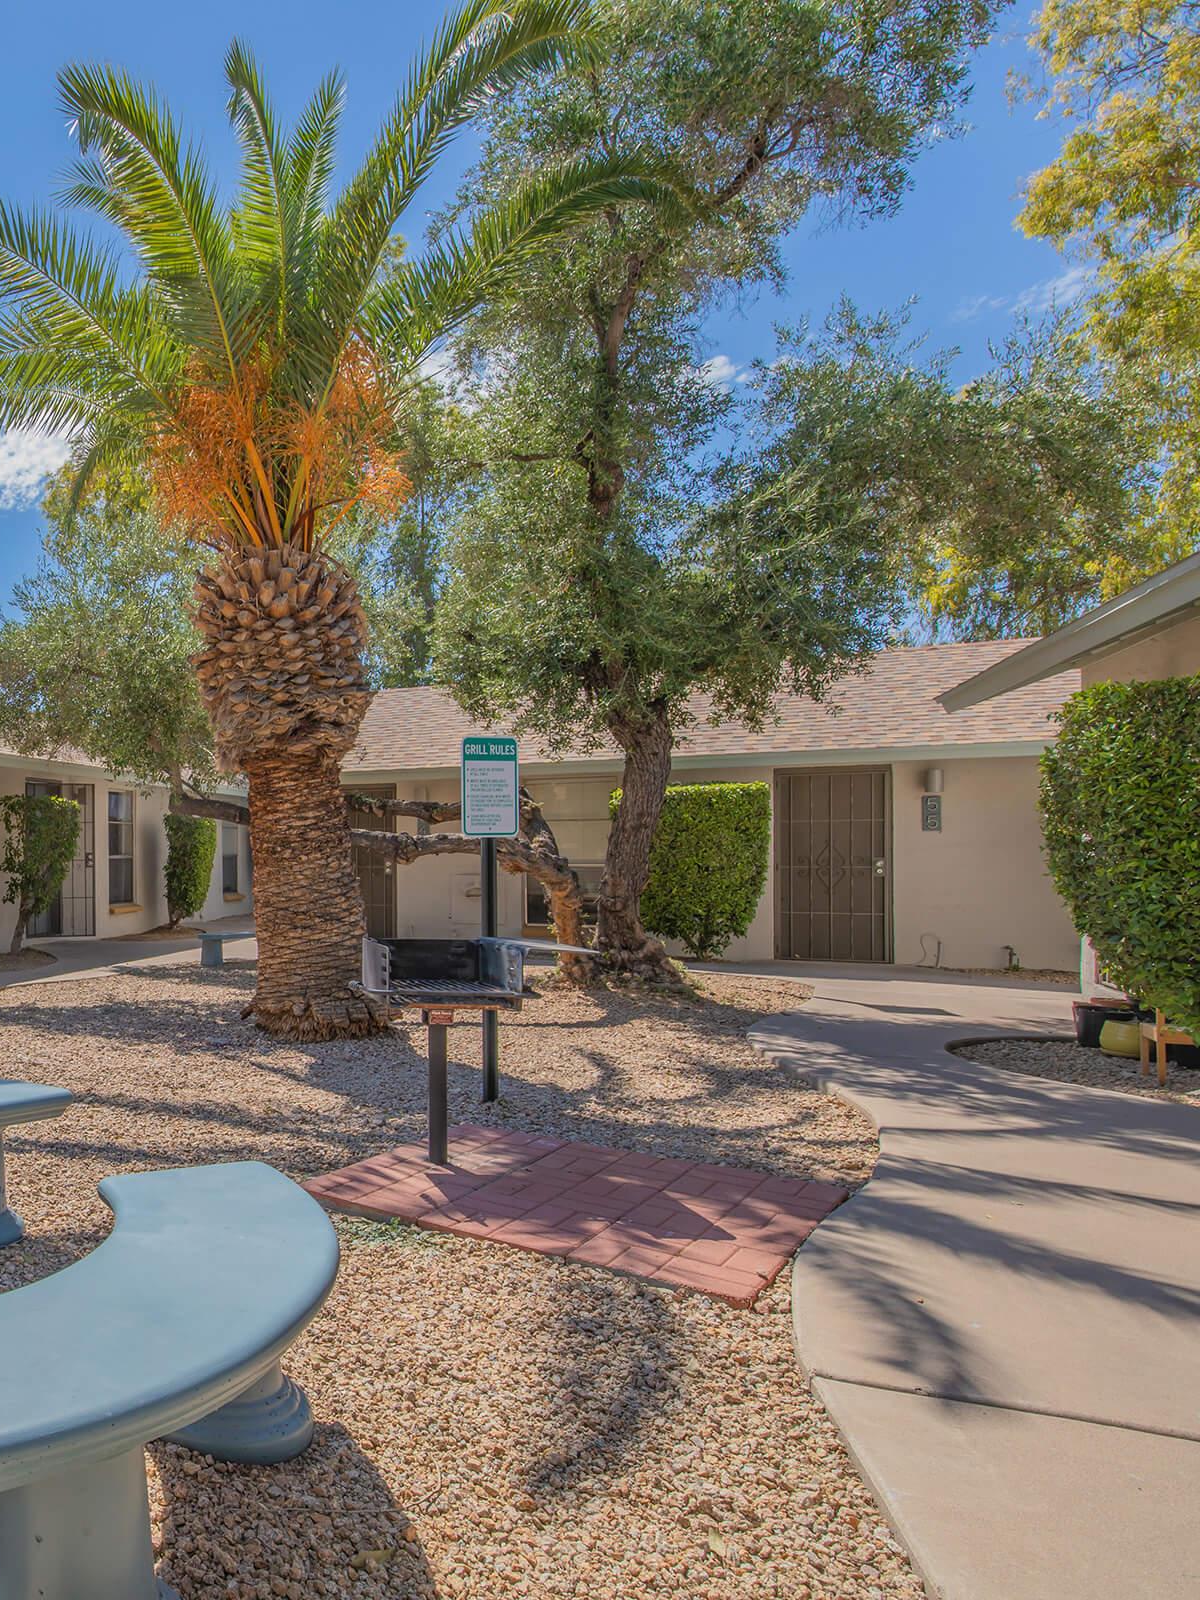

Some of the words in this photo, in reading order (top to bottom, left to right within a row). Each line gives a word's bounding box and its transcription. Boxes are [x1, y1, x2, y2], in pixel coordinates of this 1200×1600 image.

[464, 744, 488, 755] GRILL
[489, 744, 516, 755] RULES
[927, 797, 938, 828] 55
